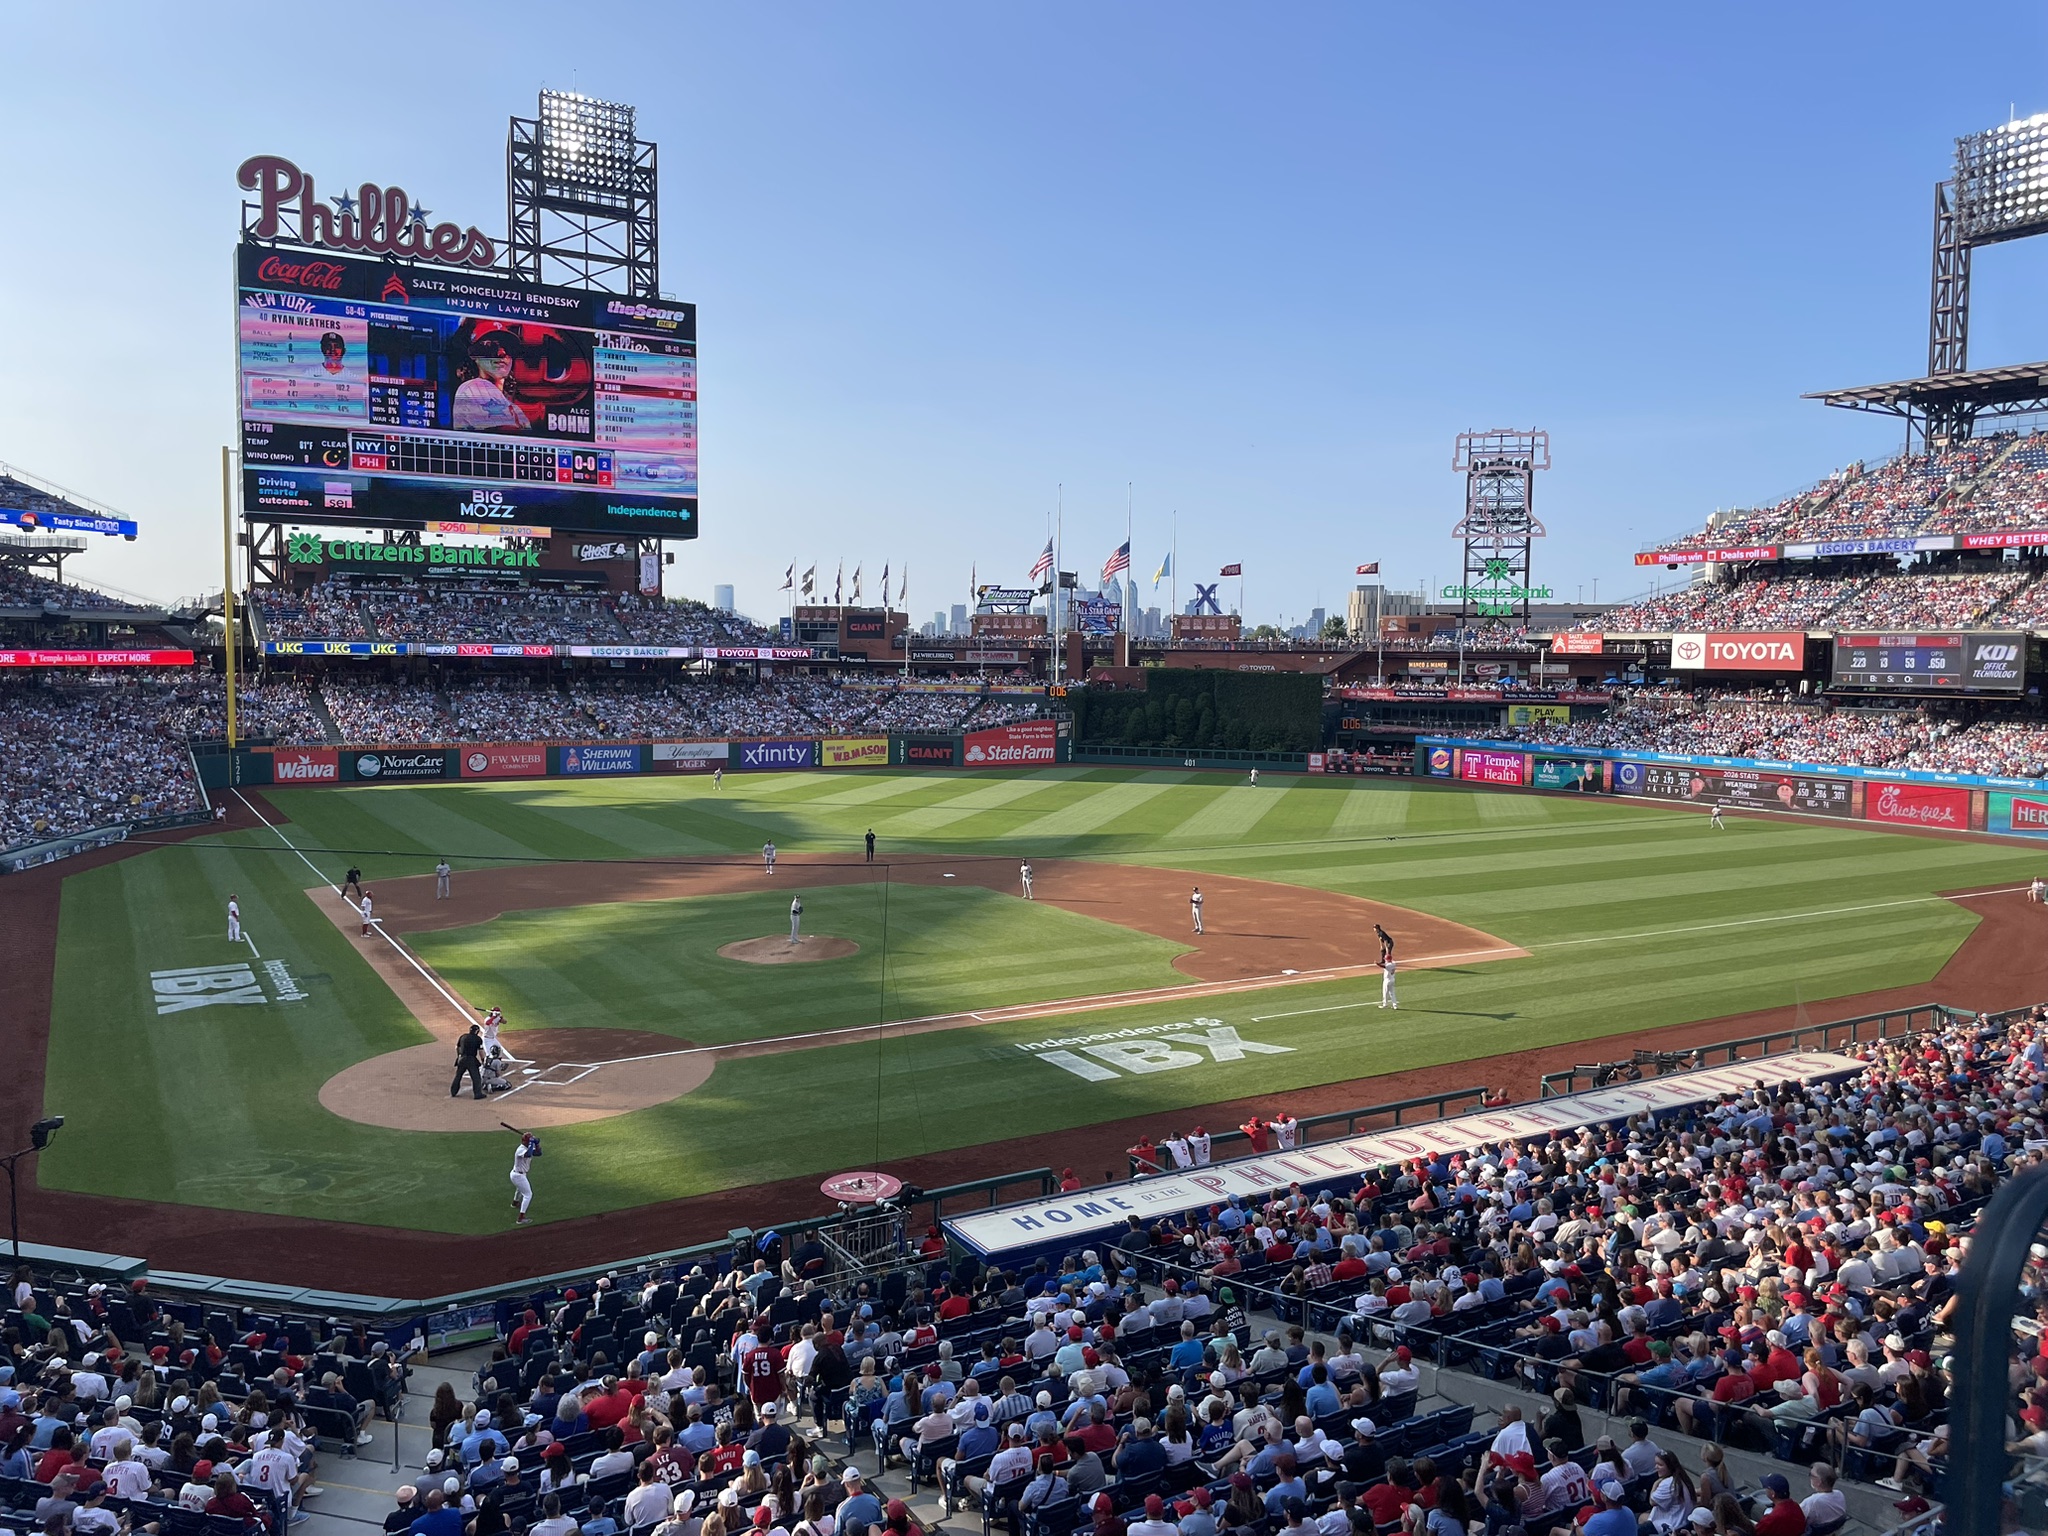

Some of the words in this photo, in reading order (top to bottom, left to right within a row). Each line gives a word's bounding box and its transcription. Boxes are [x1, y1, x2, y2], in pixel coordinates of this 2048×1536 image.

[236, 155, 496, 270] Phillies
[258, 256, 347, 290] Coca-Cola
[413, 278, 446, 291] SALTZ
[451, 284, 521, 302] MONGELUZZI
[526, 294, 580, 309] BENDESKY
[245, 292, 276, 308] NEW
[280, 294, 316, 313] YORK
[446, 298, 489, 310] INJURY
[498, 304, 550, 318] LAWYERS
[607, 301, 685, 322] theScore
[272, 314, 295, 325] RYAN
[297, 317, 341, 330] WEATHERS
[594, 332, 650, 353] Phillies
[570, 407, 590, 415] ALEC
[548, 414, 590, 434] BOHM
[246, 437, 269, 446] TEMP
[321, 440, 347, 449] CLEAR
[356, 442, 381, 452] NYY
[389, 444, 396, 453] 0
[246, 451, 269, 460] WIND
[270, 452, 294, 462] (MPH)
[359, 457, 379, 467] PHI
[574, 455, 596, 472] 0-0
[258, 477, 296, 489] Driving
[258, 487, 299, 497] smarter
[472, 490, 503, 504] BIG
[258, 496, 313, 507] outcomes.
[460, 503, 515, 519] MOZZ
[607, 504, 678, 519] Independence
[53, 517, 74, 529] Tasty
[75, 519, 94, 528] Since
[95, 520, 119, 531] 1914
[1968, 536, 2004, 546] WHEY
[2005, 534, 2048, 544] BETTER
[580, 542, 617, 562] GHOST
[1816, 543, 1864, 555] LISCIO'S
[1868, 539, 1917, 552] BAKERY
[328, 540, 425, 562] Citizens
[429, 543, 487, 565] Bank
[491, 547, 540, 567] Park
[1659, 553, 1687, 564] Phillies
[1688, 553, 1703, 562] win
[1720, 550, 1744, 559] Deals
[1744, 549, 1757, 559] roll
[1759, 549, 1769, 558] in
[984, 586, 1031, 599] Fitzpatrick
[1443, 585, 1506, 598] Citizens
[1510, 584, 1550, 598] Bank
[1104, 607, 1121, 615] GAME
[1478, 601, 1513, 616] Park
[850, 623, 882, 632] GIANT
[276, 643, 303, 654] UKG
[324, 643, 351, 654] UKG
[370, 644, 397, 654] UKG
[461, 646, 491, 655] NECA
[524, 647, 553, 656] NECA
[591, 647, 631, 656] LISCIO'S
[633, 648, 670, 657] BAKERY
[720, 649, 755, 657] TOYOTA
[775, 649, 809, 658] TOYOTA
[1710, 642, 1795, 660] TOYOTA
[1975, 644, 2019, 661] KDI
[39, 653, 64, 664] Temple
[65, 654, 87, 662] Health
[97, 653, 128, 662] EXPECT
[129, 654, 151, 663] MORE
[847, 656, 866, 664] Fanatics
[1850, 658, 1866, 668] .223
[1905, 658, 1915, 669] 53
[1928, 658, 1946, 669] .650
[1983, 662, 2007, 670] OFFICE
[1972, 670, 2018, 679] TECHNOLOGY
[1576, 694, 1610, 702] Budweiser
[1534, 708, 1555, 716] PLAY
[1021, 727, 1031, 735] good
[332, 744, 379, 752] ASPLUNDH
[441, 741, 484, 749] ASPLUNDH
[582, 748, 632, 760] SHERWIN
[669, 745, 714, 759] Yuengling
[745, 743, 807, 764] xfinity
[908, 748, 953, 759] GIANT
[1658, 753, 1686, 761] Independence
[381, 755, 444, 769] NovaCare
[491, 755, 509, 764] F.W.
[511, 754, 541, 764] WEBB
[675, 759, 707, 769] LAGER
[1184, 758, 1196, 767] 401
[1483, 754, 1520, 772] Temple
[1754, 761, 1787, 769] Independence
[277, 763, 335, 779] Wawa
[382, 768, 442, 776] REHABILITATION
[1484, 769, 1517, 782] Health
[1723, 771, 1739, 779] 2026
[1739, 772, 1760, 781] STATS
[1864, 769, 1900, 777] Independence
[1647, 775, 1659, 784] 4.47
[1986, 777, 2027, 786] Independence
[1725, 781, 1757, 790] WEATHERS
[1731, 789, 1750, 797] BOHM
[1796, 788, 1809, 797] .650
[1813, 789, 1827, 799] .286
[1831, 791, 1845, 800] .301
[1877, 791, 1955, 822] Chick-fil-A
[150, 962, 268, 1015] IBX
[1014, 1020, 1194, 1053] Independence
[1034, 1025, 1298, 1082] IBX
[1285, 1129, 1295, 1140] 35
[1011, 1195, 1135, 1232] HOME
[1141, 1191, 1158, 1201] OF
[1161, 1185, 1186, 1198] THE
[1187, 1100, 1623, 1198] PHILADELPHIA
[1626, 1053, 1837, 1105] PHILLIES
[1181, 1146, 1188, 1157] 5
[1202, 1143, 1208, 1154] 2
[1936, 1191, 1947, 1205] 13
[1234, 1215, 1241, 1226] 3
[1267, 1237, 1274, 1248] 5
[1324, 1238, 1331, 1249] 3
[1226, 1306, 1239, 1316] ANTI
[1224, 1311, 1243, 1324] SOCIAL
[885, 1340, 902, 1354] 10
[752, 1360, 771, 1377] 19
[1247, 1413, 1267, 1427] HARPER
[257, 1453, 281, 1464] HARPER
[656, 1453, 670, 1466] LEE
[107, 1466, 130, 1478] HARPER
[260, 1465, 270, 1482] 3
[656, 1462, 683, 1485] 33
[110, 1478, 119, 1495] 3
[1567, 1477, 1587, 1503] 27
[699, 1488, 718, 1500] RIZZO
